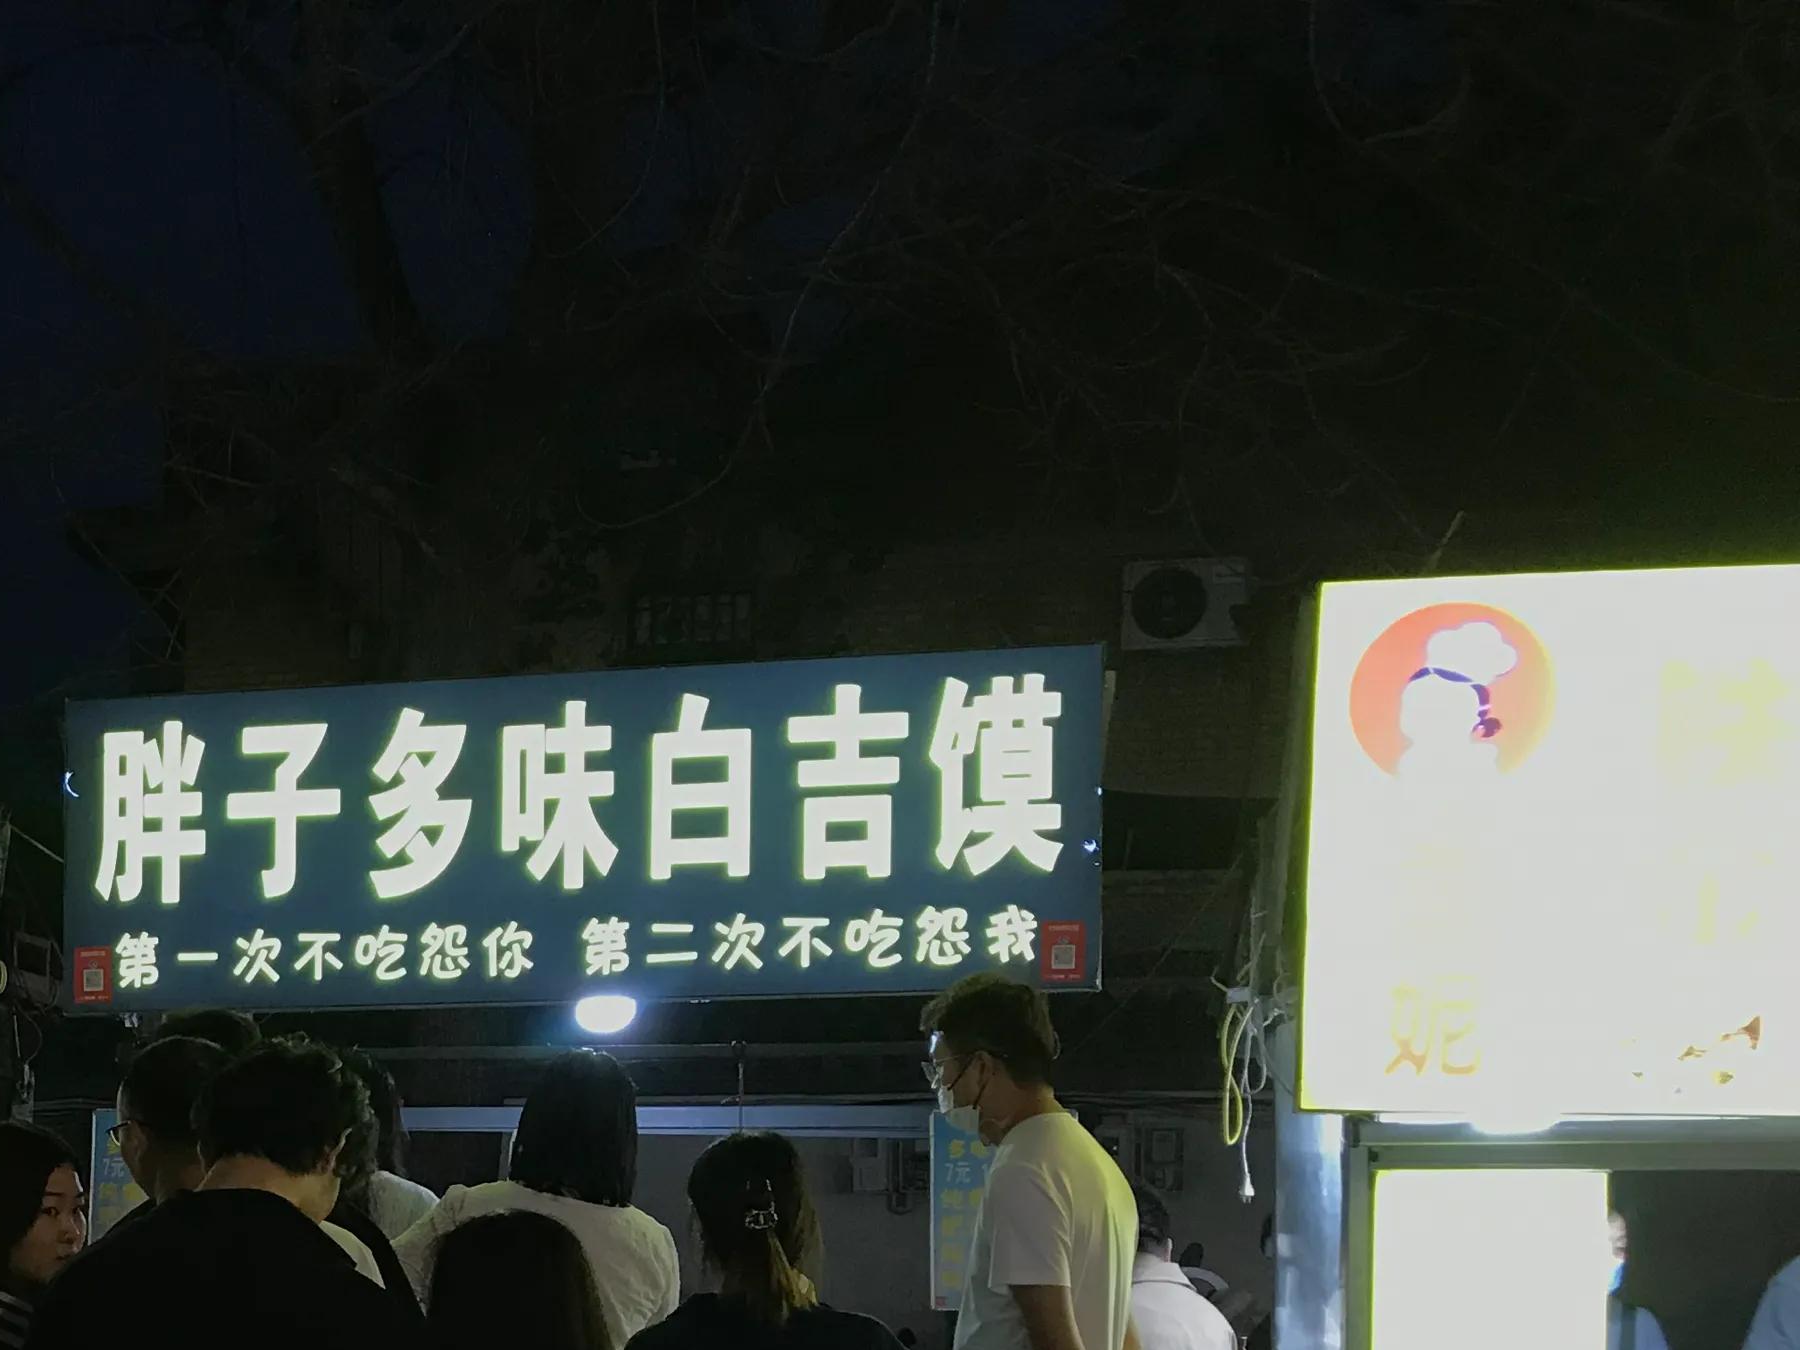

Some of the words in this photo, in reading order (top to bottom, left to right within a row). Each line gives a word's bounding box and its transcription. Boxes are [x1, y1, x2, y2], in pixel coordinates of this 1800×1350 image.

[93, 671, 1066, 906] 胖子多味白吉馍
[114, 920, 536, 989] 第一次不吃怨你
[580, 903, 1039, 977] 第二次不吃怨我
[944, 1161, 971, 1185] 7元
